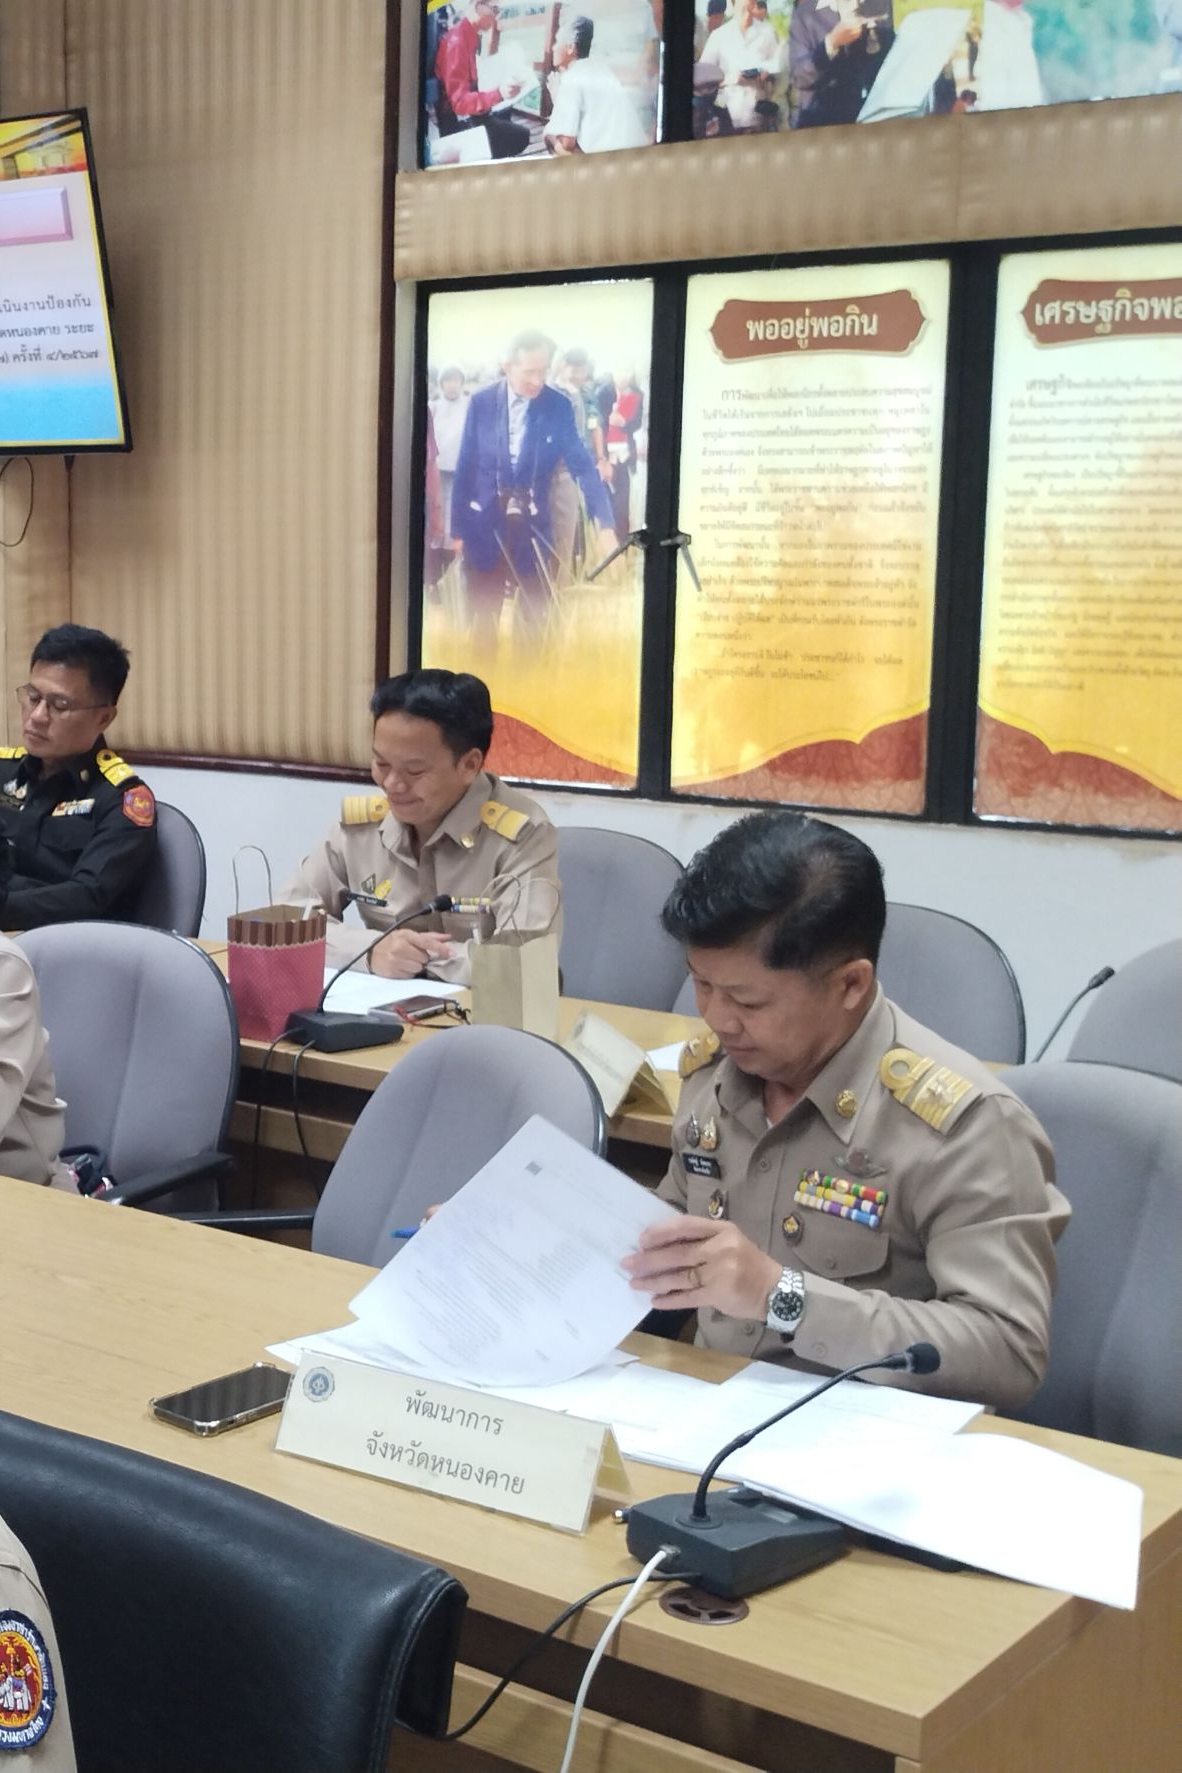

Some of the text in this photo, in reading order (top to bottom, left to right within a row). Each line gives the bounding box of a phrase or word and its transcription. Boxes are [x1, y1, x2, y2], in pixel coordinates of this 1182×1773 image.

[745, 304, 878, 350] พออยู่พอกิน
[405, 1389, 505, 1436] พัฒนาการ
[365, 1430, 525, 1496] จังหวัดหนองคาย
